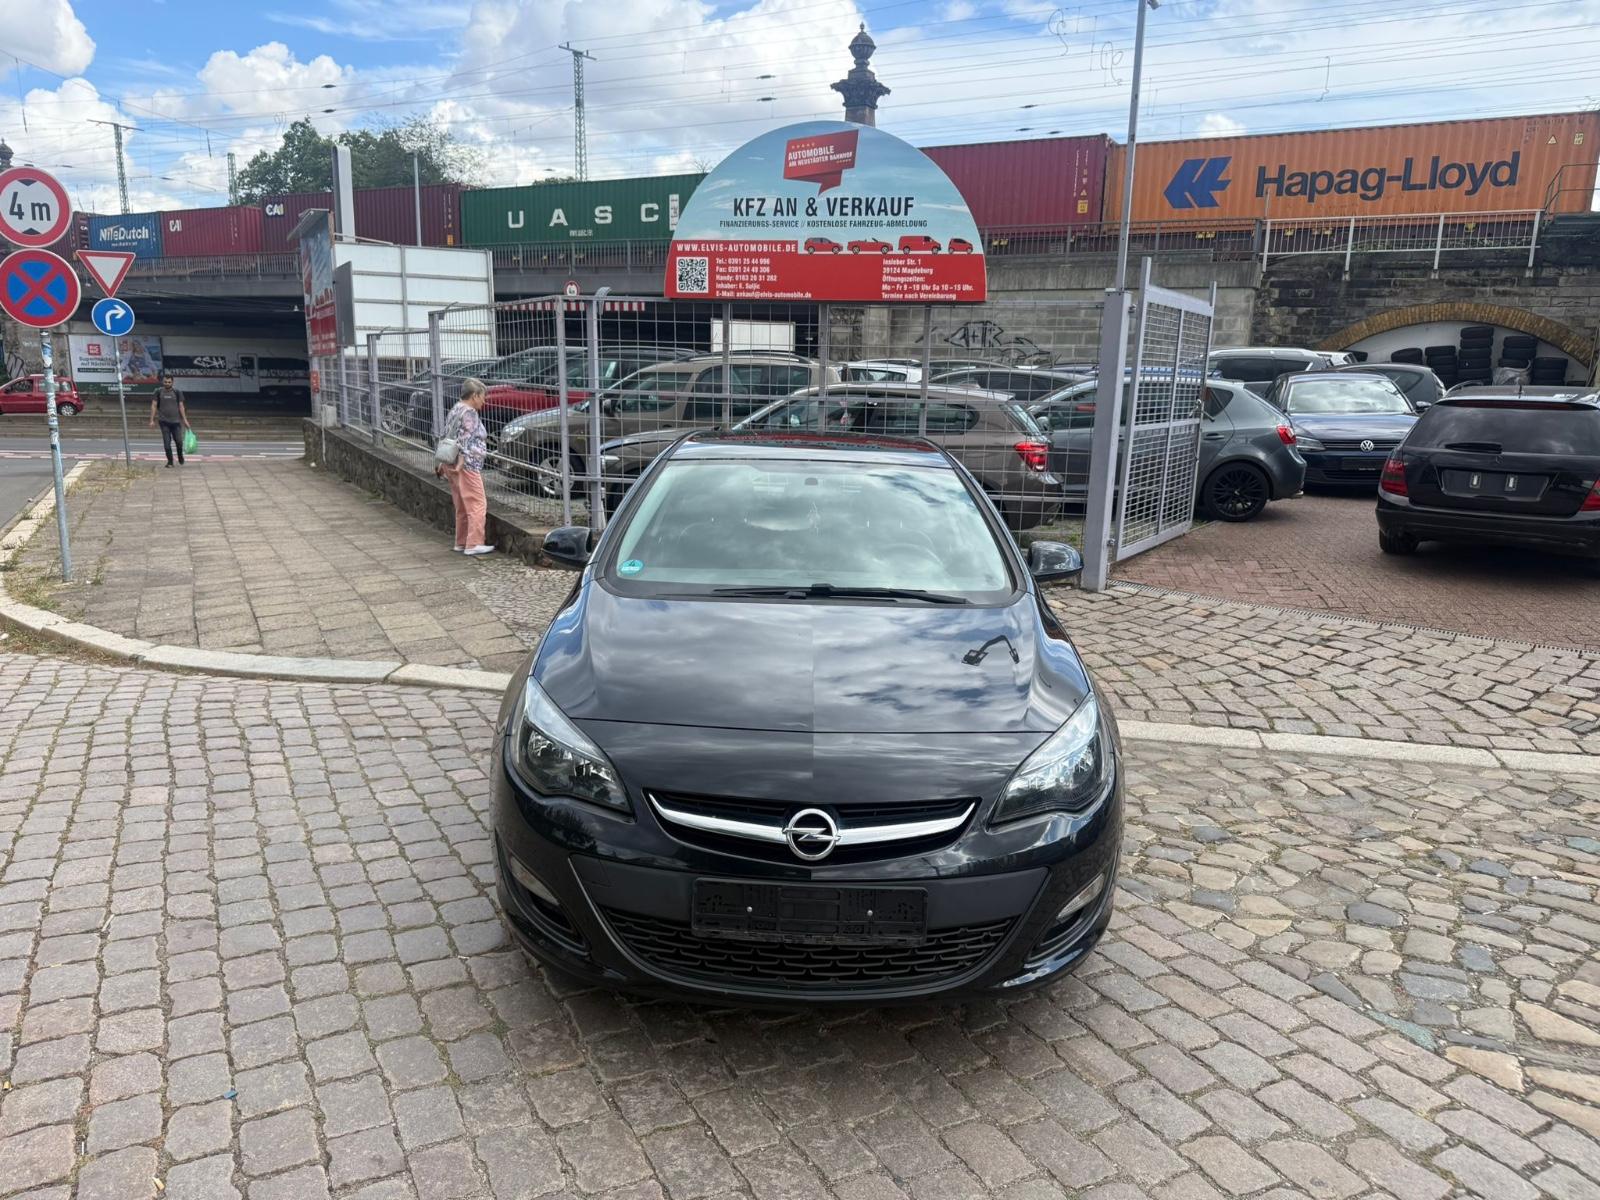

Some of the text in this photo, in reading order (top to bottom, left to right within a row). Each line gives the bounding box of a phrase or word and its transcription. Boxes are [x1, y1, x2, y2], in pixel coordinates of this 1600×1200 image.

[788, 145, 834, 161] AUTOMOBILE
[1255, 150, 1521, 203] Hapag-Lloyd
[9, 191, 51, 222] 4 m
[733, 196, 914, 217] KFZ AN & VERKAUF
[719, 220, 799, 229] FINANZIERUNGS-SERVICE
[807, 220, 848, 229] KOSTENLOSE
[849, 220, 928, 229] FAHRZEUG-ABMELDUNG
[676, 243, 797, 252] WWW.ELVIS-AUTOMOBILE.DE
[901, 267, 934, 275] Magdeburg
[882, 275, 925, 283] Öffnungszeiten:
[919, 292, 956, 300] Vereinbarung
